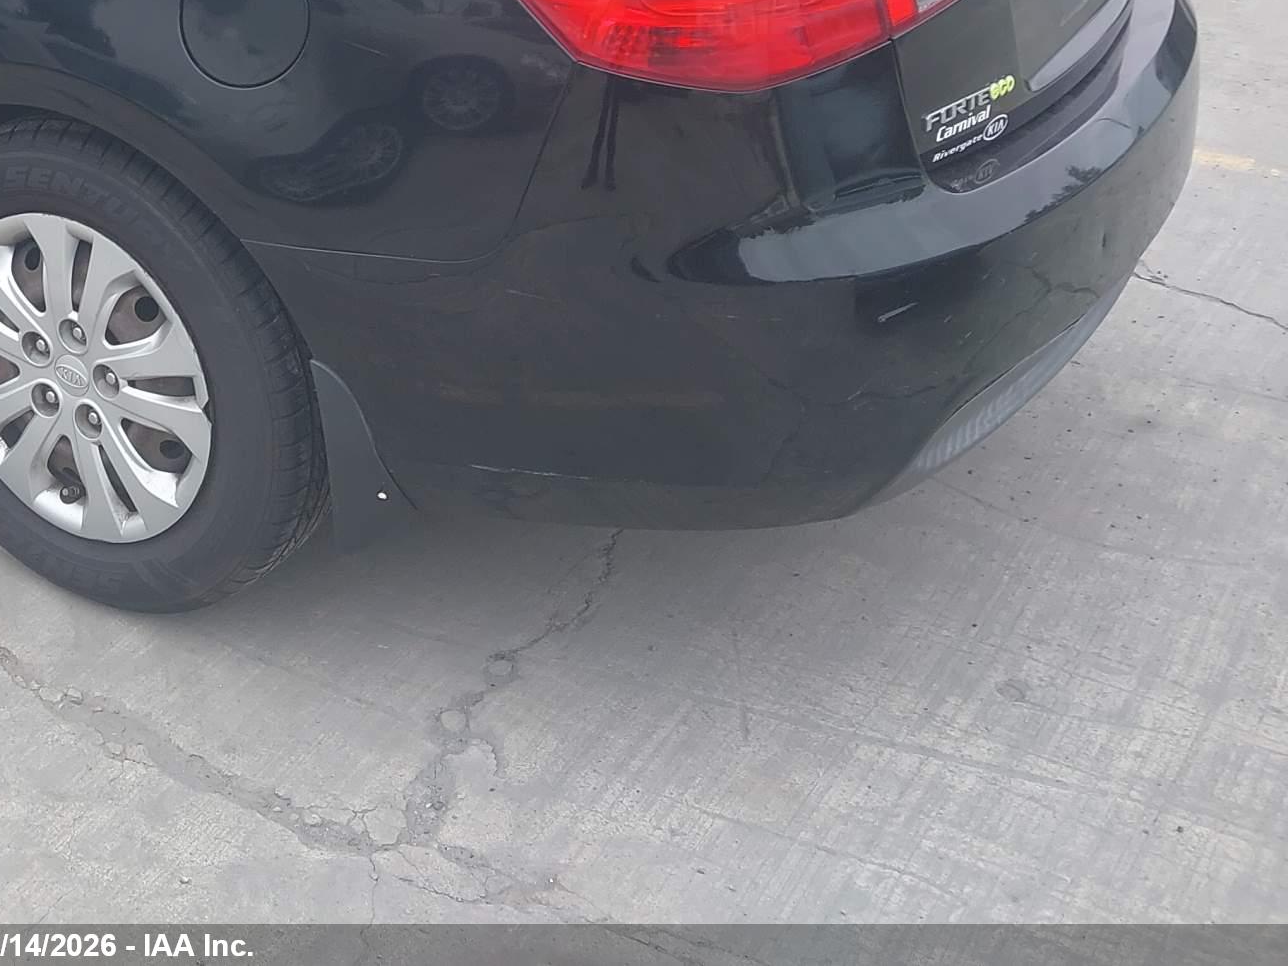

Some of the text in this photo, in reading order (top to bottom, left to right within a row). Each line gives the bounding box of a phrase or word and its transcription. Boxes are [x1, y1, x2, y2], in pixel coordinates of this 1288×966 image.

[923, 86, 991, 131] FORTE
[936, 104, 992, 142] Carnival
[932, 117, 1006, 163] Rivergate KIA
[58, 366, 85, 387] KIA
